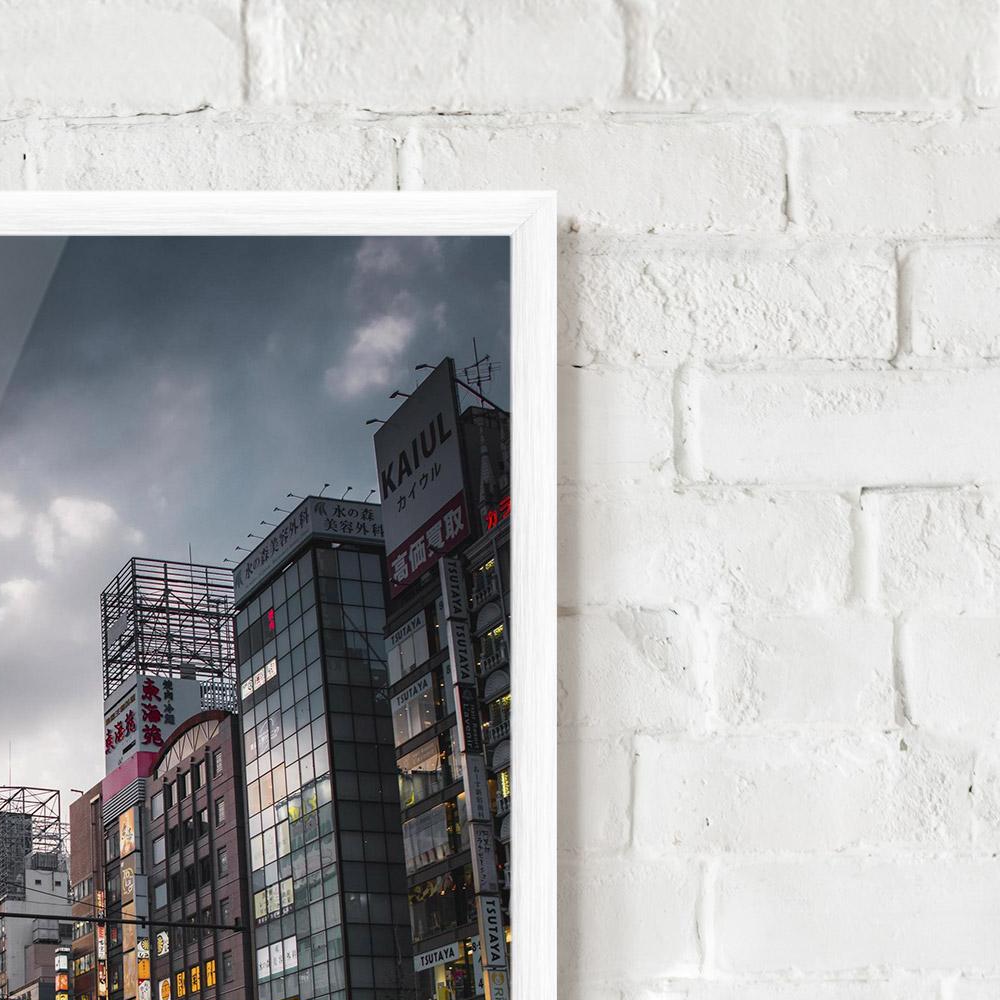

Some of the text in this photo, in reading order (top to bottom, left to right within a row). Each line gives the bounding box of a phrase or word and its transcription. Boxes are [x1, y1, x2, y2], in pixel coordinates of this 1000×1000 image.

[381, 412, 451, 499] KAIUL
[397, 462, 441, 512] カイウル
[326, 518, 384, 538] 美容外科
[333, 505, 375, 522] 水の森
[244, 508, 309, 579] 水の森美容外科
[391, 506, 464, 583] 高価買取
[447, 562, 462, 614] TSUTAYA
[391, 617, 421, 645] TSUTAYA
[455, 626, 470, 680] TSUTAYA
[141, 678, 164, 747] 東海苑
[397, 680, 428, 705] TSUTAYA
[420, 947, 455, 967] TSUTAYA
[485, 900, 501, 962] TSUTAYA
